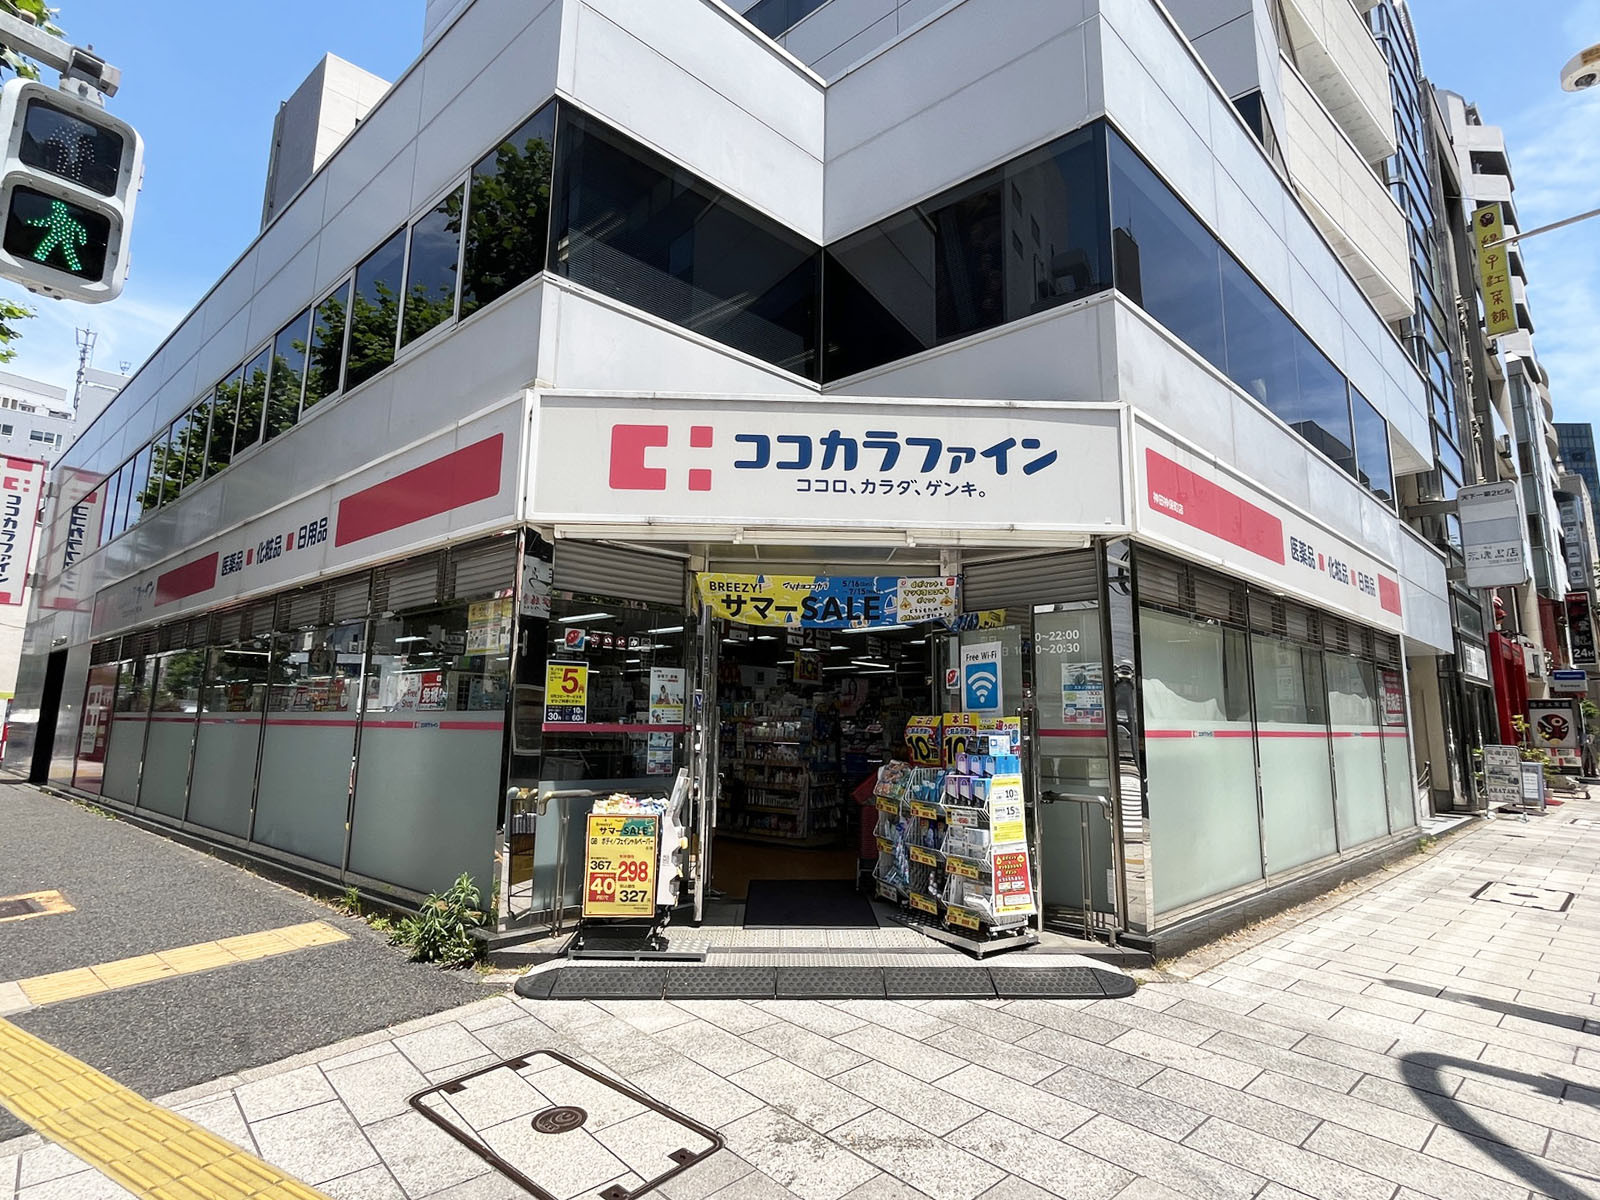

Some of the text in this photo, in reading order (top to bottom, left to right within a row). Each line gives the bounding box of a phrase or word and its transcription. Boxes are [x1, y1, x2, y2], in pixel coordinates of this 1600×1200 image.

[734, 428, 1059, 476] ココカラファイン
[796, 477, 987, 498] ココロ、カラダ、ゲンキ。
[297, 516, 328, 549] 日用品
[256, 534, 282, 566] 化粧品
[1289, 535, 1316, 570] 医薬品
[221, 550, 244, 576] 医薬品
[1328, 555, 1350, 585] 化粧品
[709, 580, 762, 594] BREEZY!
[1357, 571, 1377, 597] 日用品
[721, 594, 880, 621] サマーSALE
[981, 651, 997, 661] Wi-Fi
[952, 714, 970, 723] 本日
[599, 827, 649, 835] サマーSALE
[590, 860, 612, 870] 367
[617, 860, 649, 882] 298
[590, 877, 615, 895] 40
[619, 890, 648, 903] 327
